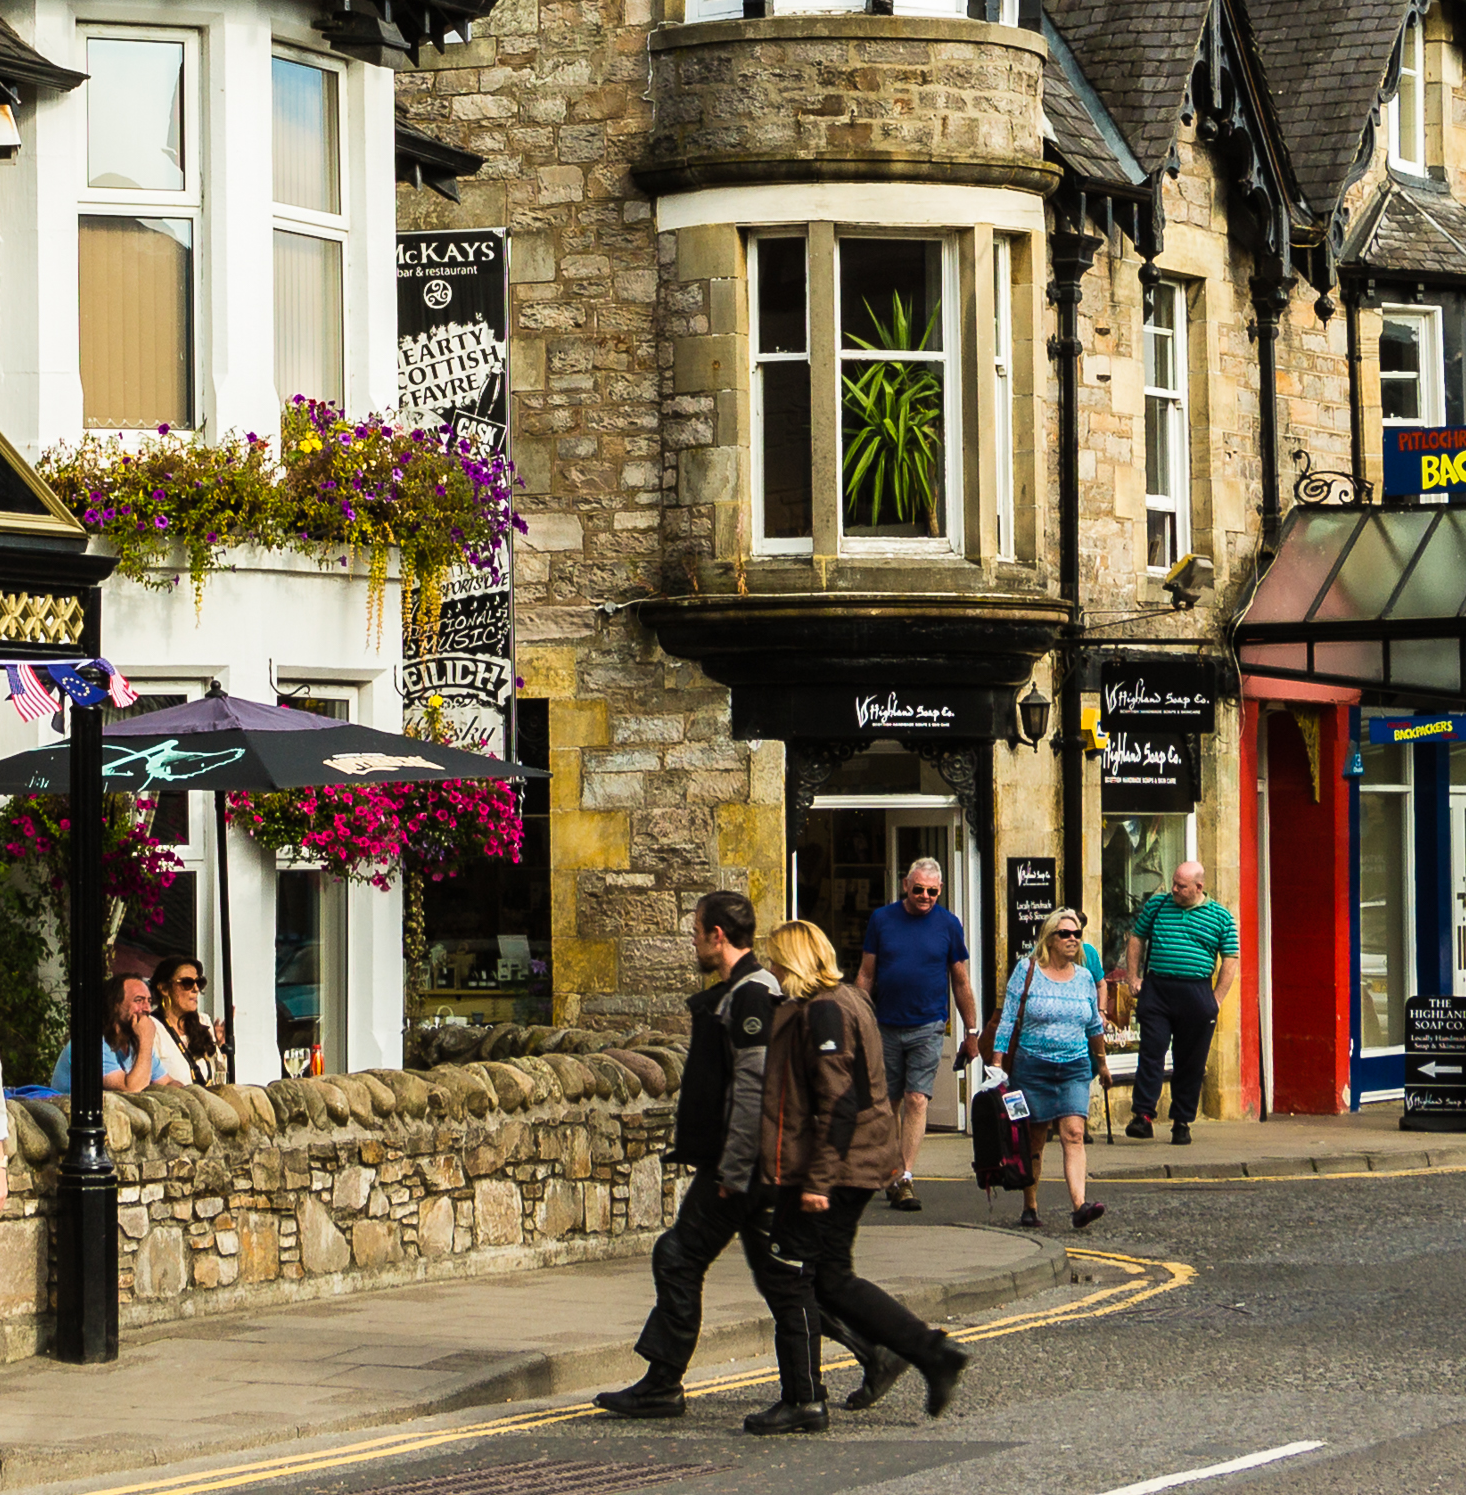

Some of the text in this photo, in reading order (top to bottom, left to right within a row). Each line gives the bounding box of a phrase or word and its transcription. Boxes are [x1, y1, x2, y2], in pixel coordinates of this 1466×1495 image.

[397, 265, 478, 278] bar & restaurant
[398, 345, 502, 391] COTTISH
[410, 373, 480, 407] FAYRE
[457, 417, 497, 446] CASK
[403, 660, 500, 693] EILIDH
[870, 691, 914, 724] Highland
[915, 705, 940, 721] Soap
[1118, 678, 1210, 711] Highland Soap Co.
[1394, 721, 1453, 741] BACKPACKERS
[1103, 732, 1141, 776] Highland
[1143, 741, 1166, 774] Soap
[1429, 999, 1452, 1008] THE
[1411, 1034, 1433, 1042] Locally
[1415, 1020, 1465, 1030] SOAP CO.
